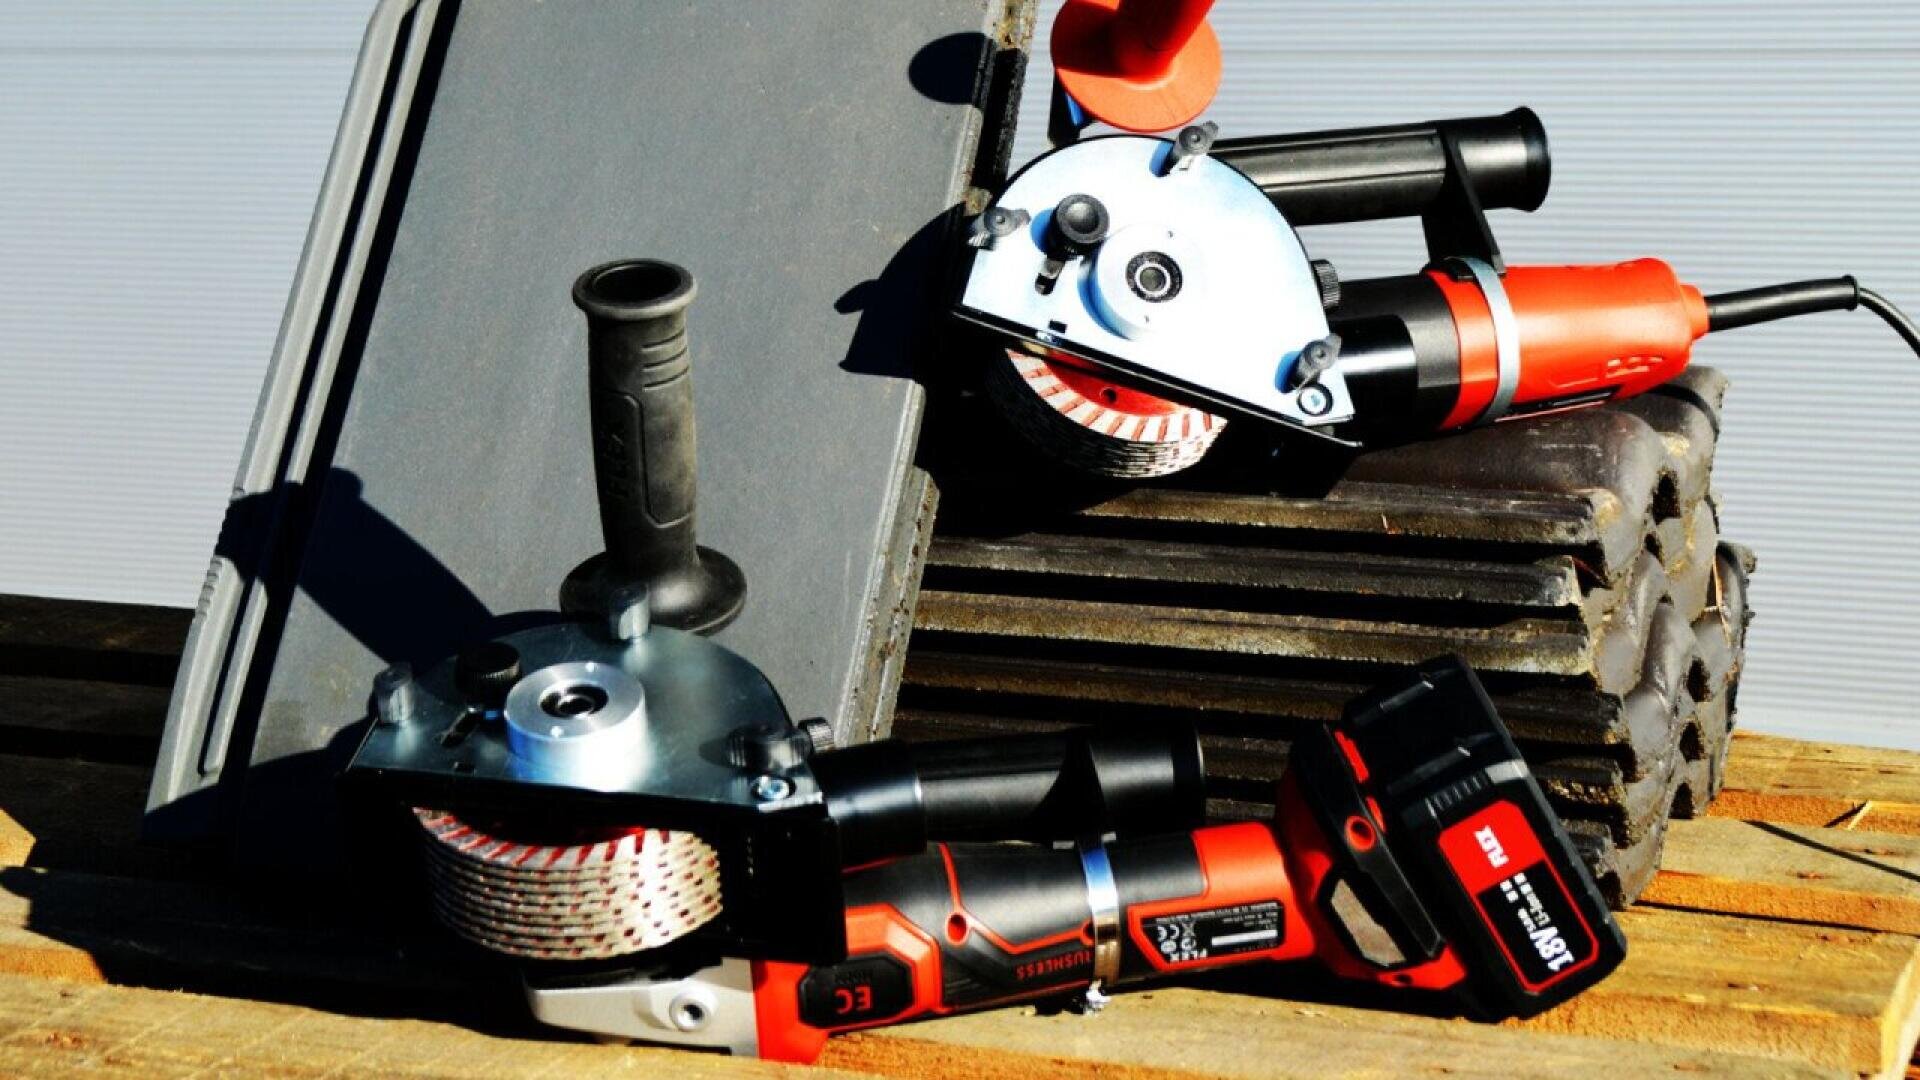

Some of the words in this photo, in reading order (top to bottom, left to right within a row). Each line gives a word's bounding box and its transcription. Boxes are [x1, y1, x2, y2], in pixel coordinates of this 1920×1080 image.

[1474, 825, 1509, 868] FLEX
[1529, 926, 1575, 971] 18V
[834, 985, 873, 1014] EC
